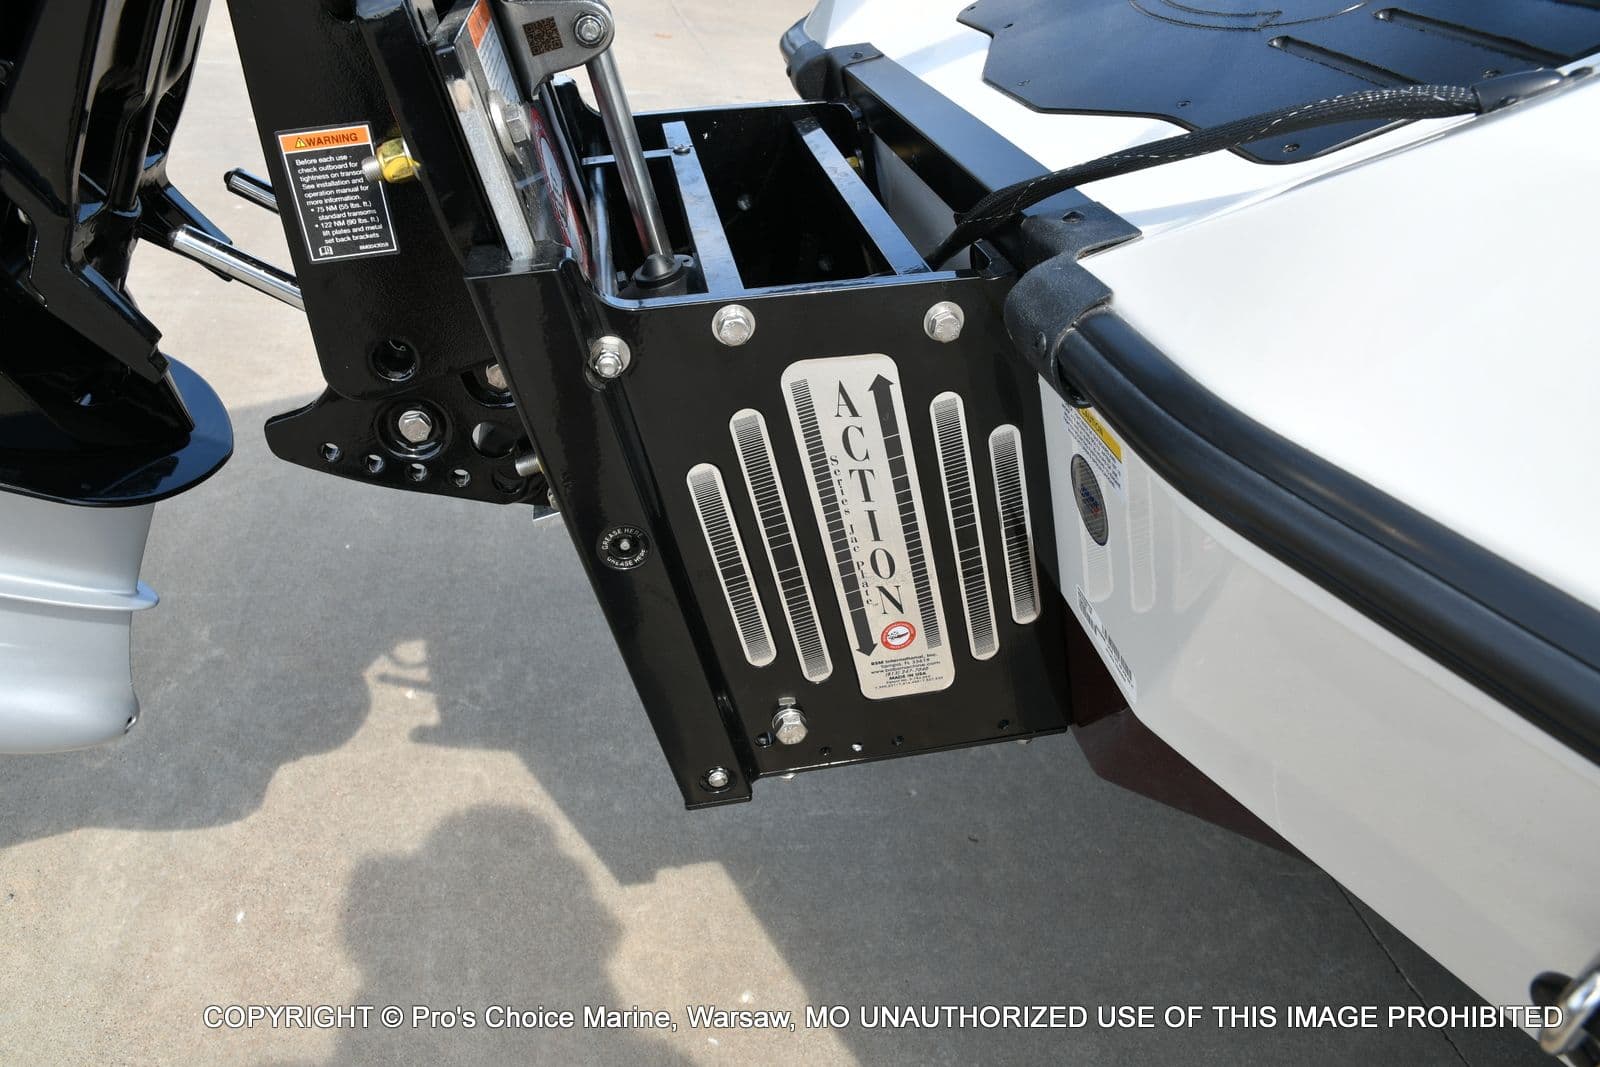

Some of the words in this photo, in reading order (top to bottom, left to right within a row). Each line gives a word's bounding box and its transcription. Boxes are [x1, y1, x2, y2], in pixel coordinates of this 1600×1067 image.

[306, 133, 358, 147] WARNING
[295, 158, 317, 167] Before
[319, 155, 335, 163] each
[298, 166, 317, 174] check
[319, 162, 348, 172] outboard
[300, 174, 330, 183] tightness
[302, 182, 315, 190] See
[316, 178, 351, 188] installation
[304, 188, 335, 199] operation
[336, 185, 360, 194] manual
[324, 194, 362, 204] information.
[317, 205, 325, 213] 75
[326, 204, 337, 212] NM
[339, 203, 349, 211] (55
[350, 201, 362, 209] lbs.
[363, 200, 372, 208] ft.)
[318, 211, 346, 220] standard
[347, 208, 377, 217] transoms
[320, 221, 332, 229] 122
[333, 219, 346, 227] NM
[347, 218, 357, 226] (90
[322, 229, 331, 237] lift
[332, 227, 351, 237] plates
[352, 225, 364, 233] and
[365, 223, 383, 231] metal
[335, 235, 351, 243] back
[352, 232, 380, 241] brackets
[834, 380, 904, 615] ACTION
[601, 528, 624, 550] GREASE
[624, 527, 644, 539] HERE
[606, 555, 634, 567] GREASE
